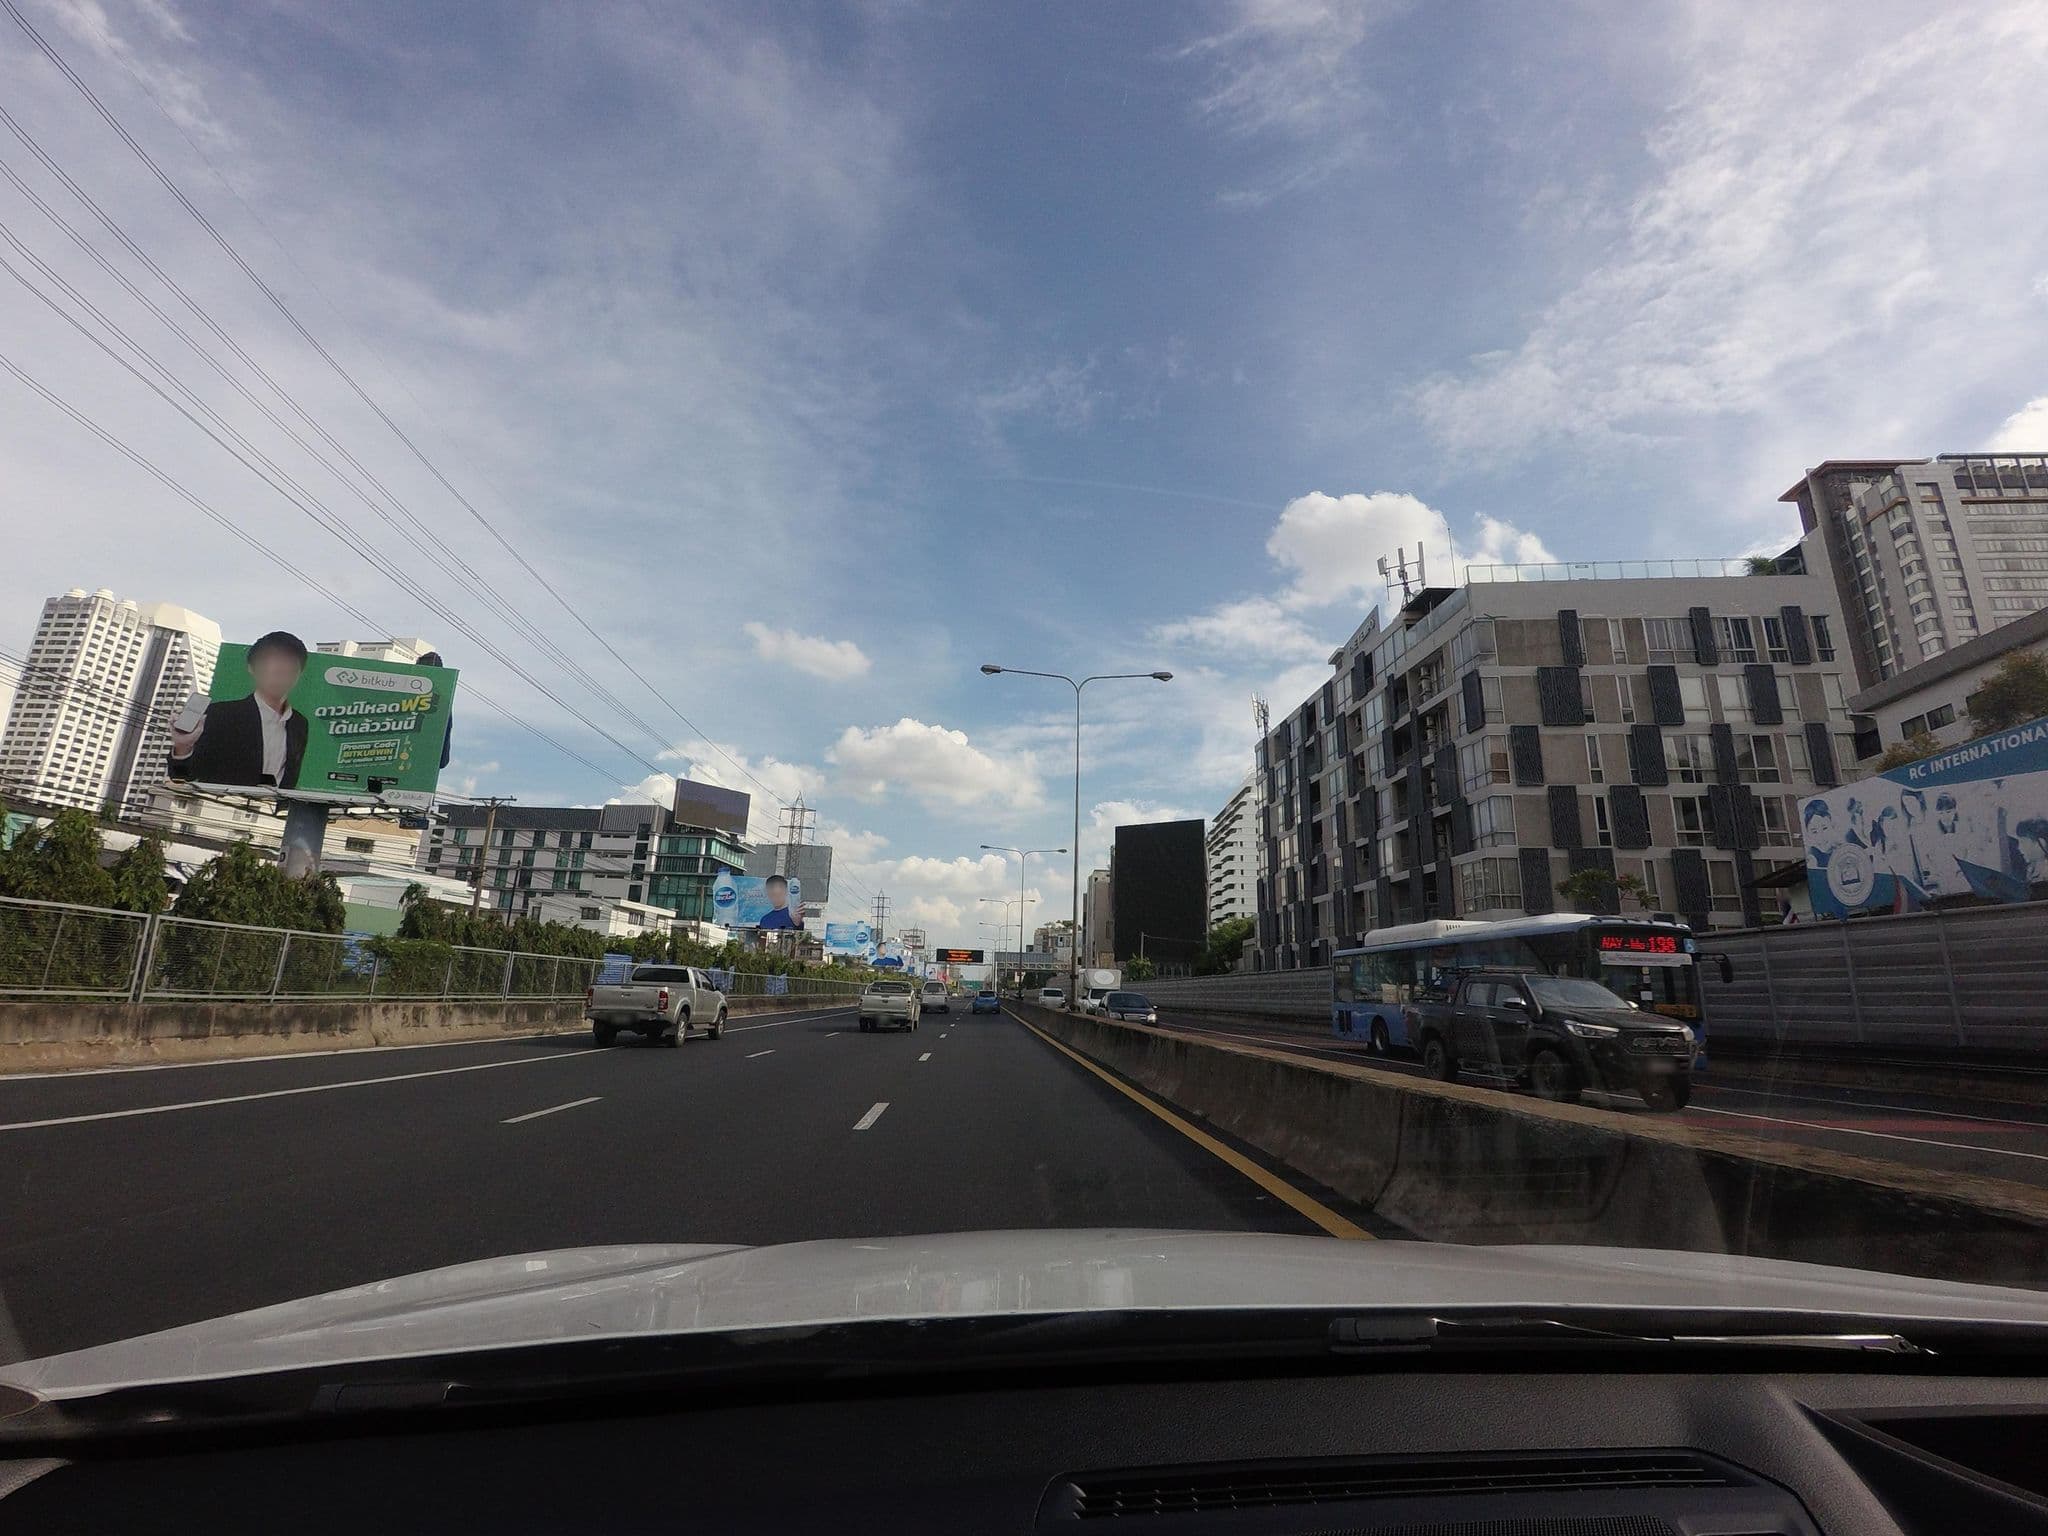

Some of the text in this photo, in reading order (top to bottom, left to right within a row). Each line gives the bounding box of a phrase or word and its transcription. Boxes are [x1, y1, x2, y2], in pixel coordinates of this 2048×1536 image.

[361, 675, 396, 688] bitkub
[328, 712, 419, 735] ได้แล้ววันนี้
[342, 741, 397, 751] Promo Code
[1908, 722, 2048, 781] RC INTERNATIONA
